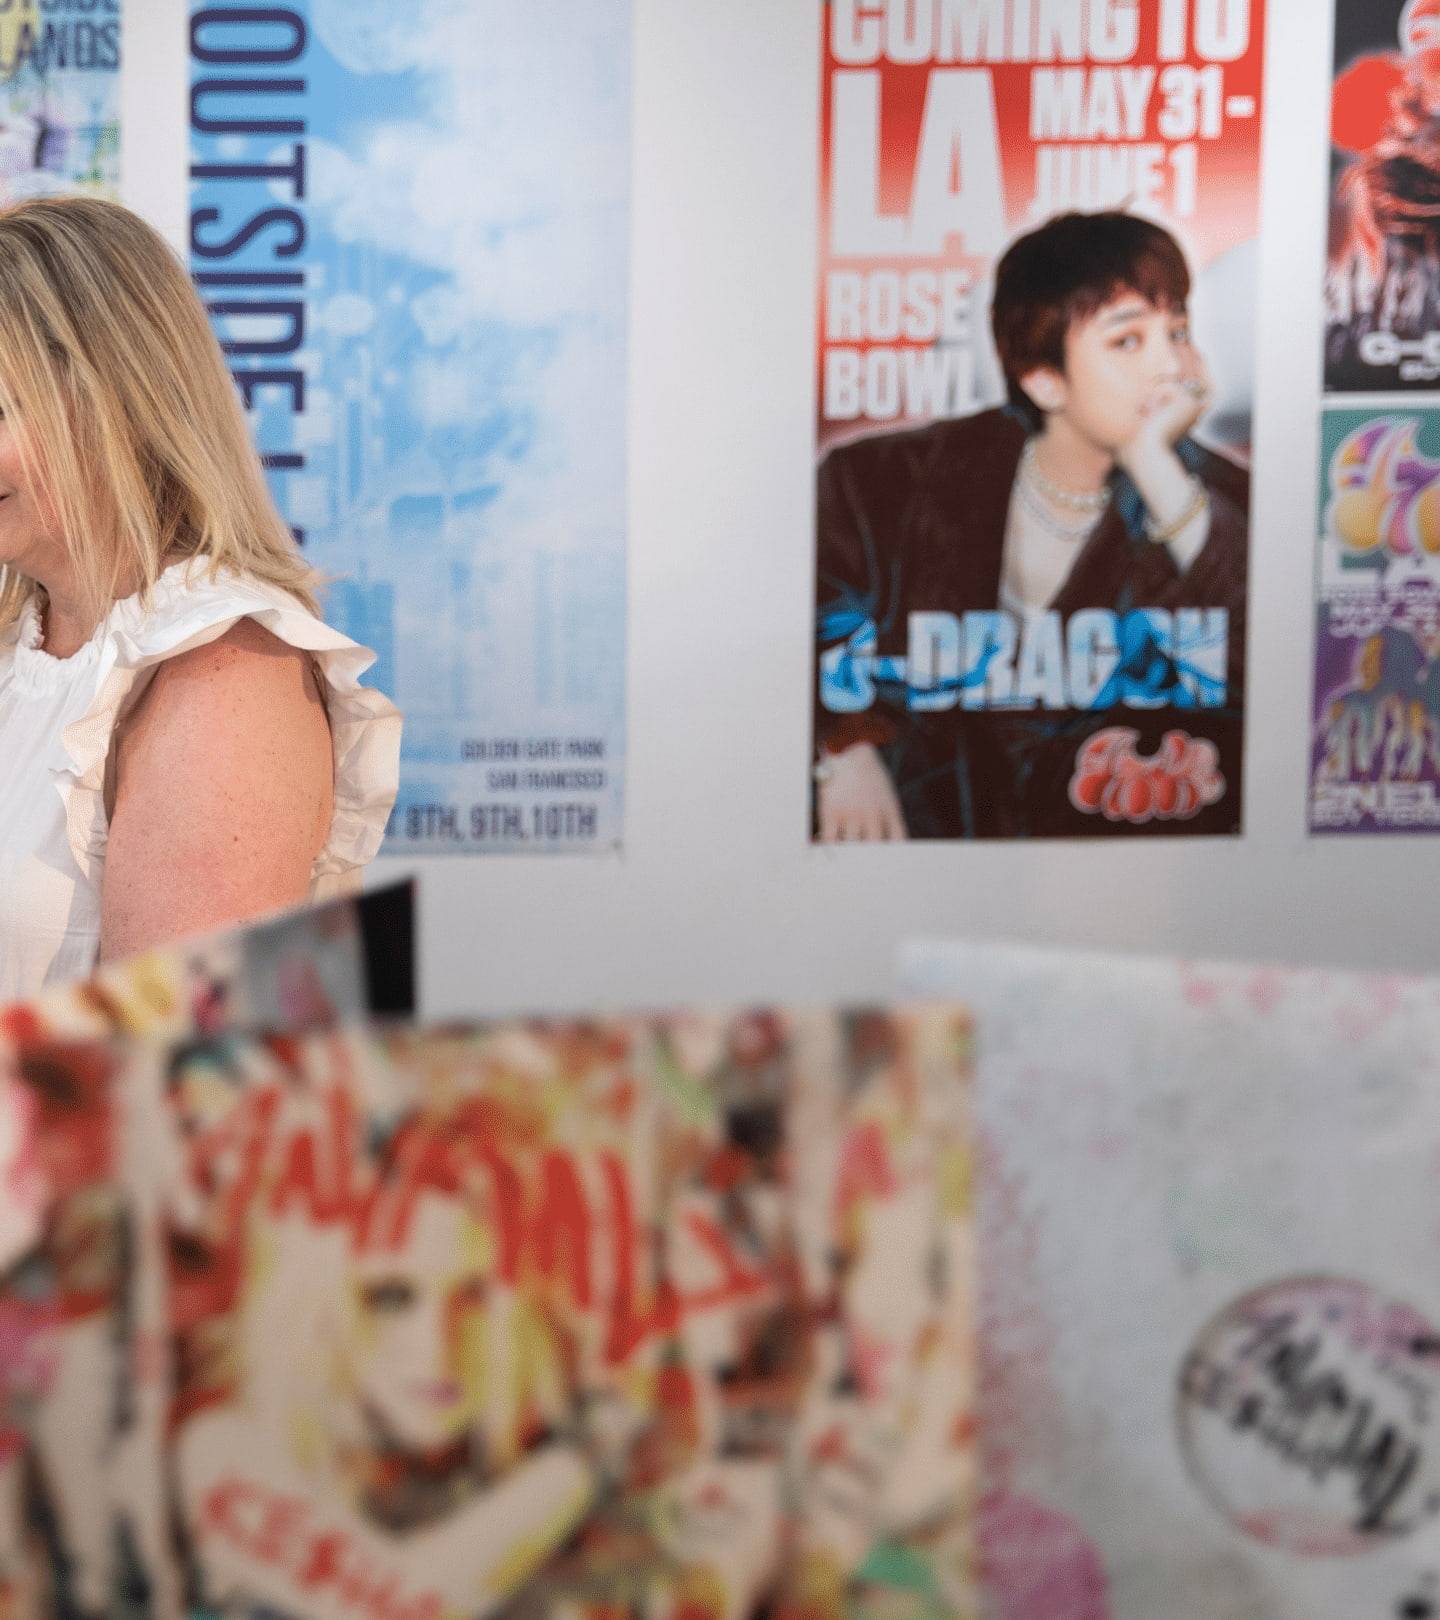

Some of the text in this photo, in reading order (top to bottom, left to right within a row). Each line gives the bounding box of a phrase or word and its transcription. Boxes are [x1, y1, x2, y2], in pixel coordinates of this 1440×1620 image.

[829, 0, 1143, 64] COMING
[1030, 66, 1156, 139] MAY
[830, 68, 1008, 257] LA
[189, 8, 307, 414] OUTSIDE
[827, 270, 974, 339] ROSE
[825, 350, 1000, 421] BOWL
